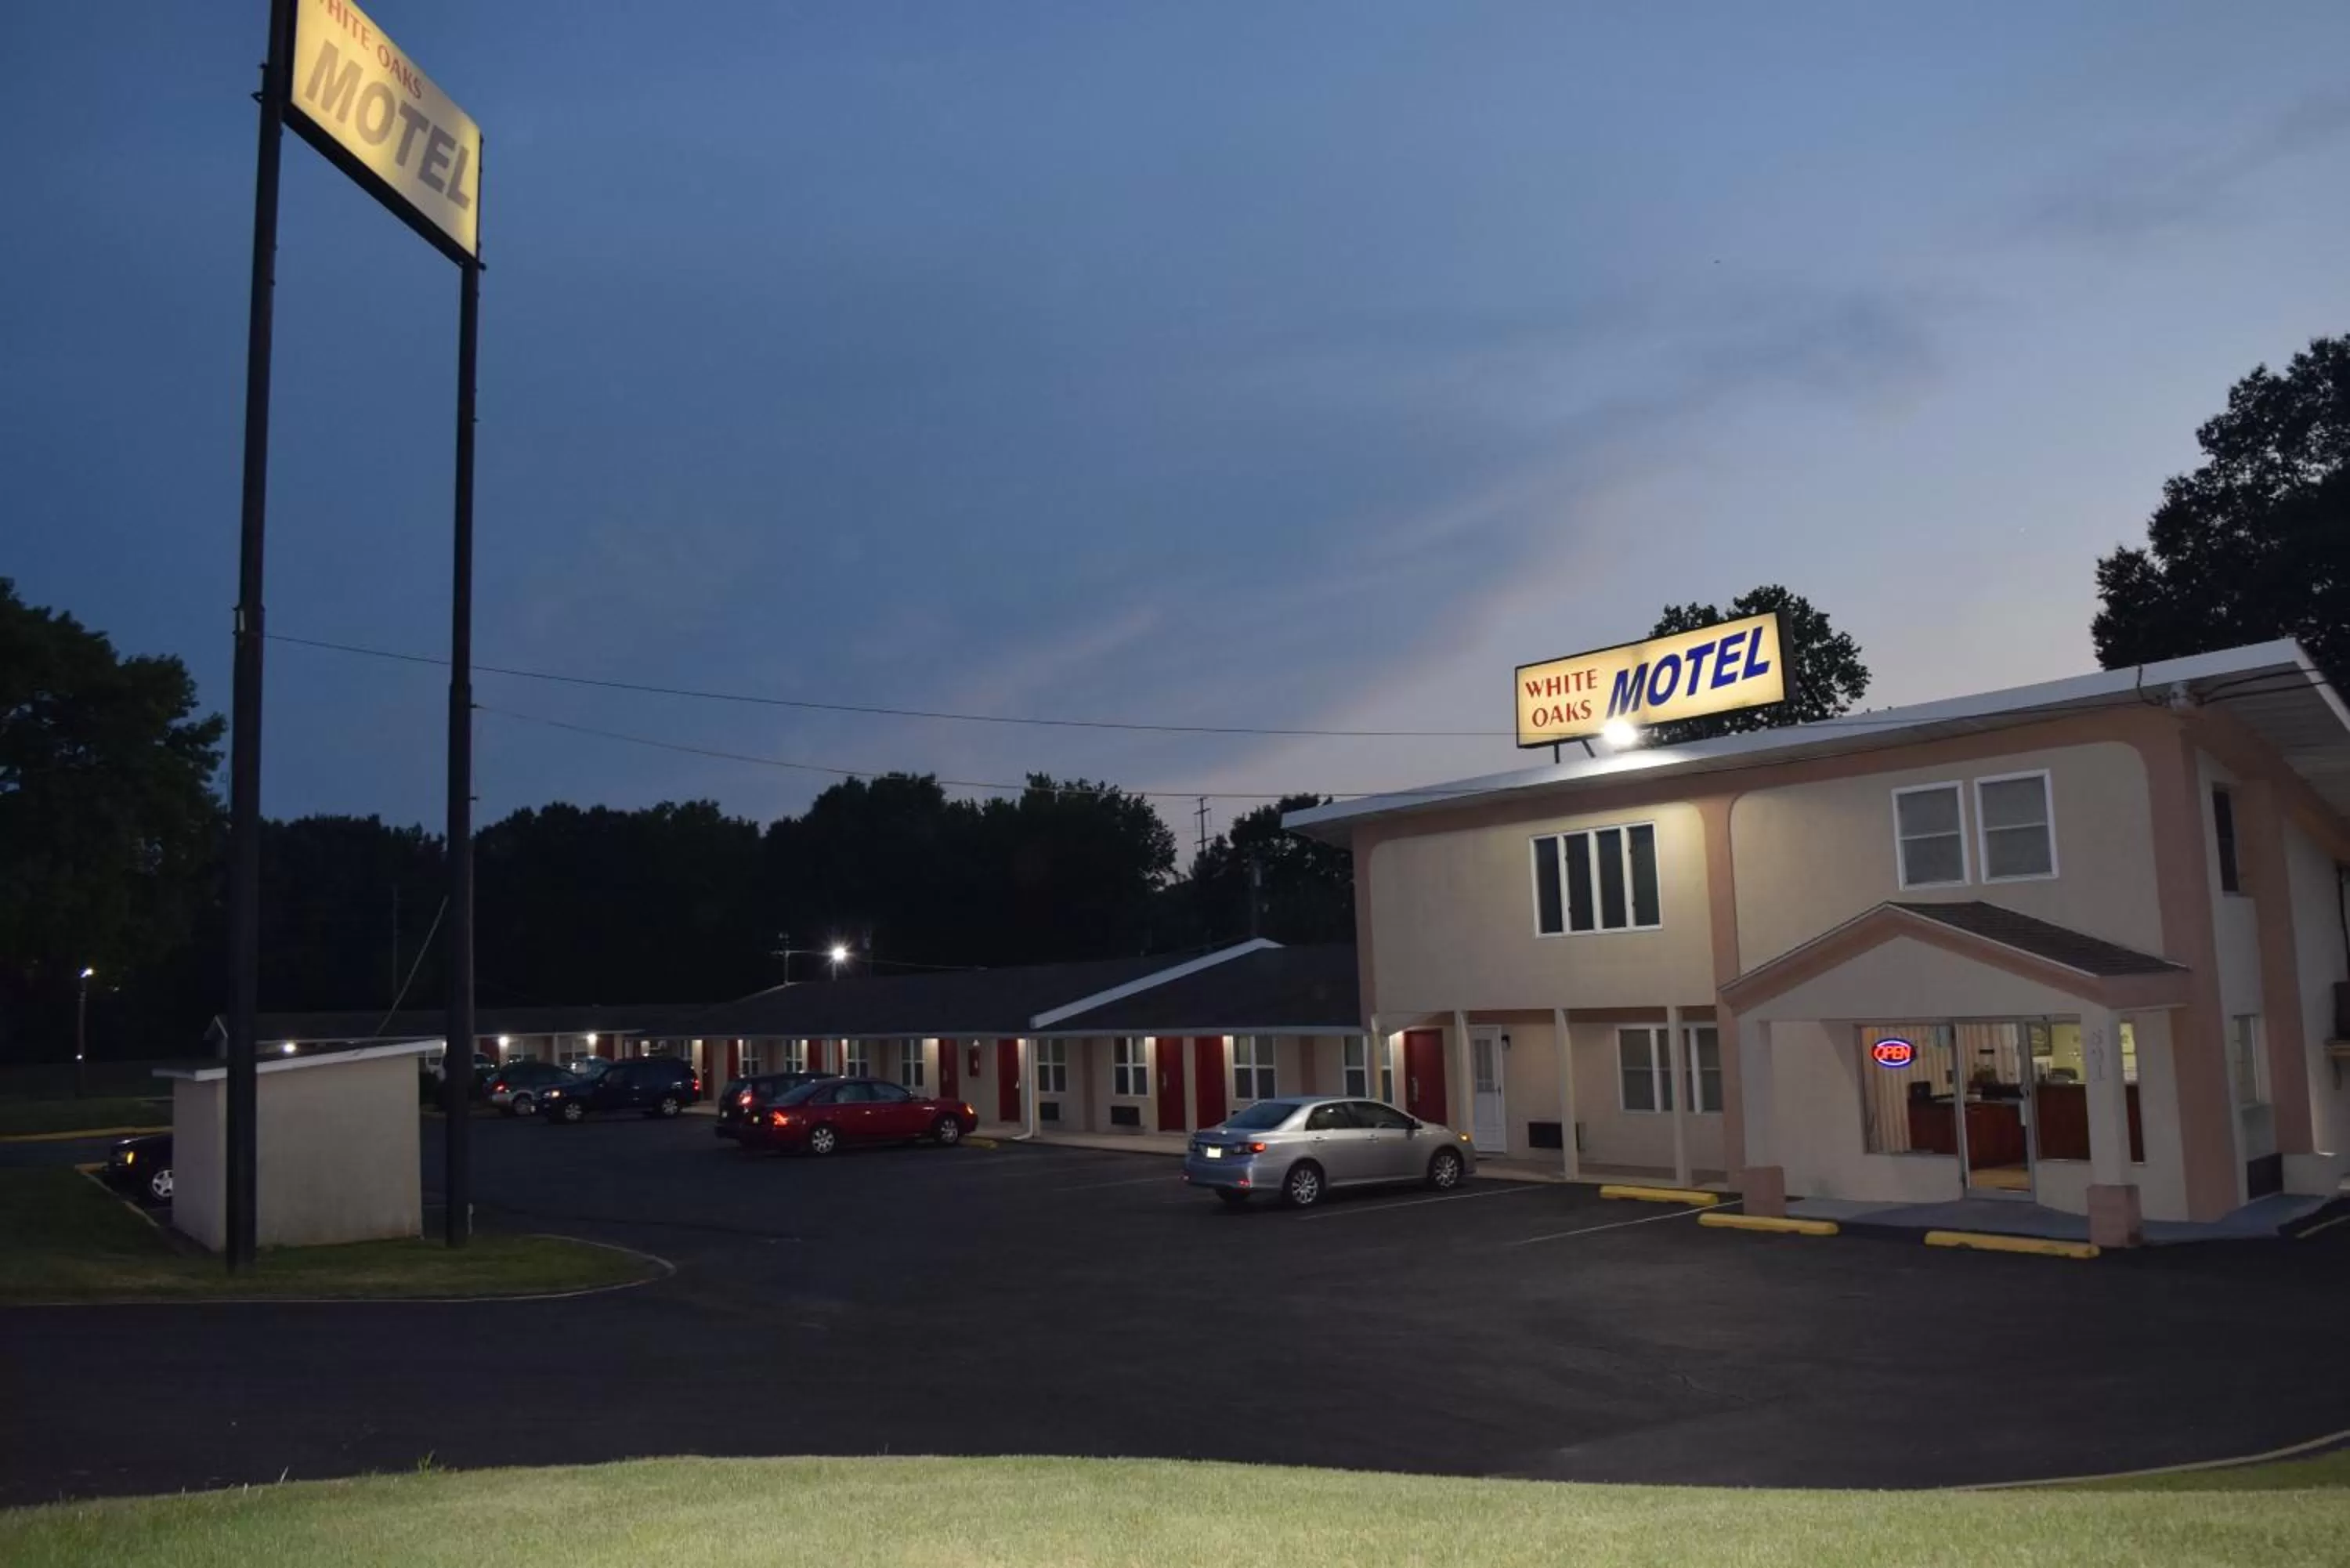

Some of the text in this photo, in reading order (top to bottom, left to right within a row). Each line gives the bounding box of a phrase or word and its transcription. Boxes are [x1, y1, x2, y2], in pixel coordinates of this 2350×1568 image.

[318, 0, 422, 99] HITE OAKS
[305, 39, 471, 211] MOTEL
[1525, 668, 1598, 699] WHITE
[1606, 627, 1770, 718] MOTEL
[1531, 699, 1593, 727] OAKS
[1873, 1046, 1911, 1060] OPEN
